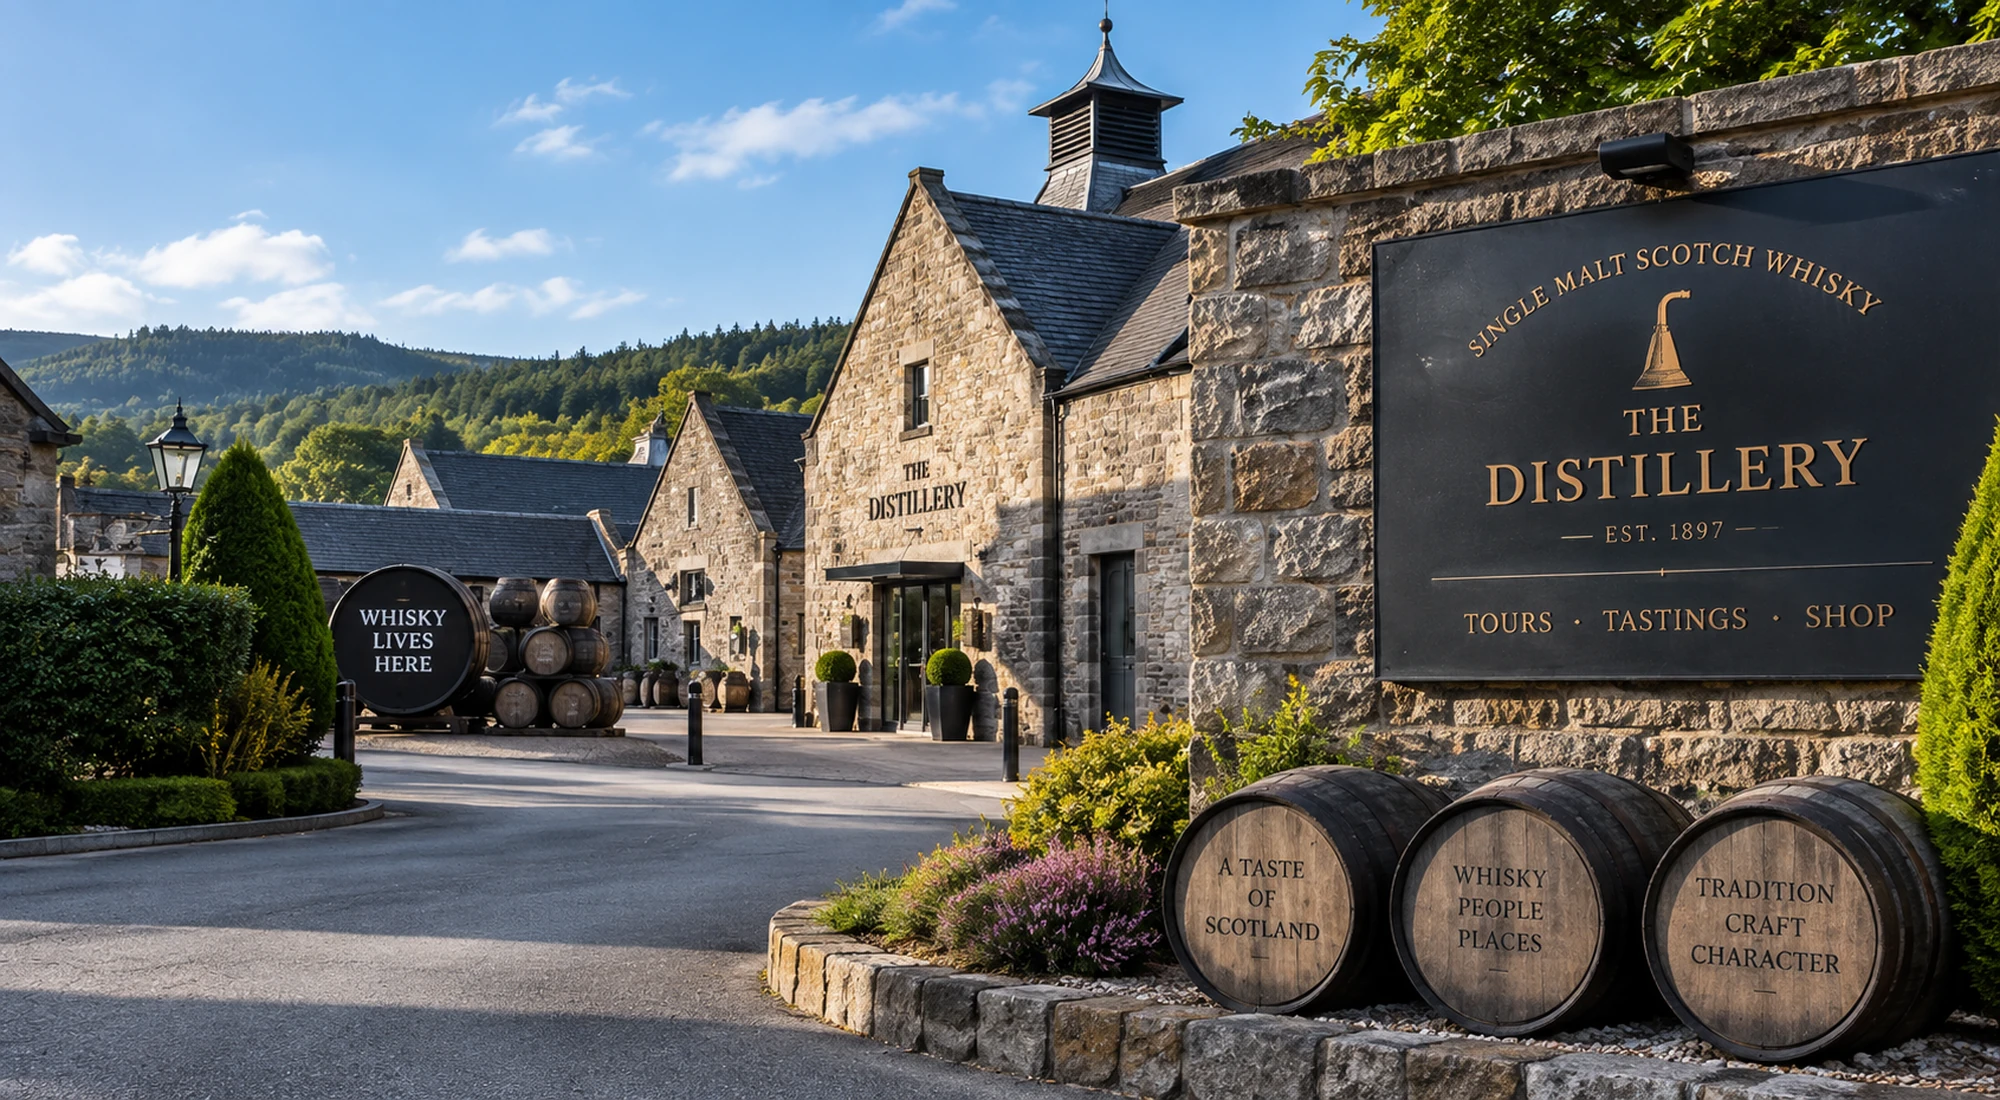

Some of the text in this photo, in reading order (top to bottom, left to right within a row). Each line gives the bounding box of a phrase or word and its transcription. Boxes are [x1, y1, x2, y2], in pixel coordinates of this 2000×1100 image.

[1468, 242, 1882, 358] SINGLE MALT SCOTCH WHISKY
[1623, 404, 1703, 436] THE
[903, 460, 930, 481] THE
[1485, 437, 1868, 506] DISTILLERY
[868, 481, 967, 521] DISTILLERY
[1605, 521, 1724, 544] EST. 1897
[359, 609, 446, 626] WHISKY
[1464, 603, 1895, 634] TOURS TASTINGS SHOP
[373, 632, 433, 649] LIVES
[375, 656, 432, 673] HERE
[1218, 858, 1305, 879] A TASTE
[1453, 865, 1547, 889] WHISKY
[1248, 889, 1275, 907] OF
[1696, 877, 1835, 904] TRADITION
[1458, 897, 1544, 921] PEOPLE
[1205, 916, 1320, 941] SCOTLAND
[1725, 912, 1806, 937] CRAFT
[1458, 929, 1542, 953] PLACES
[1691, 944, 1840, 974] CHARACTER
